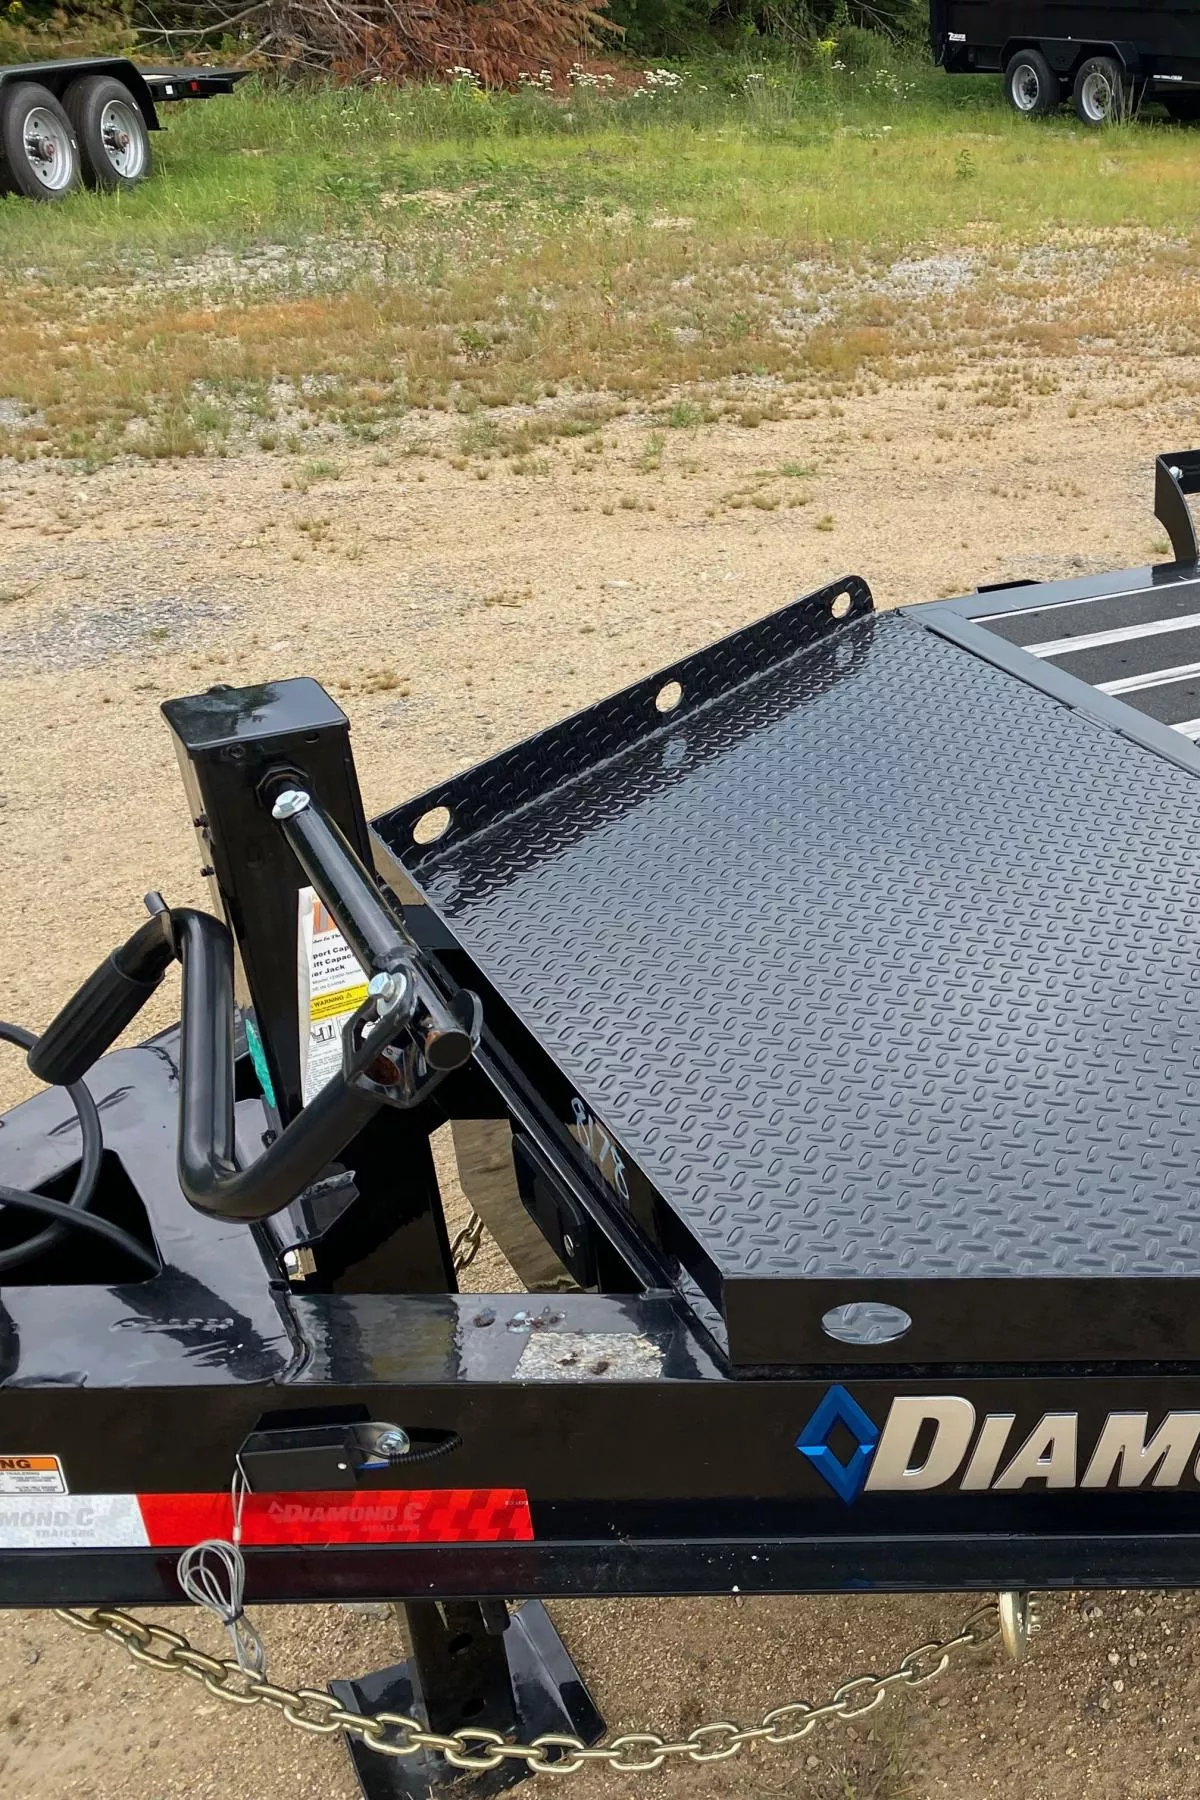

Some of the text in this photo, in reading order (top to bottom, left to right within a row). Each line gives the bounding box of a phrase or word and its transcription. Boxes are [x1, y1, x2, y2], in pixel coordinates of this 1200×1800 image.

[325, 965, 345, 975] Jack
[313, 994, 344, 1008] WARNING
[283, 1501, 423, 1523] DIAMOND C
